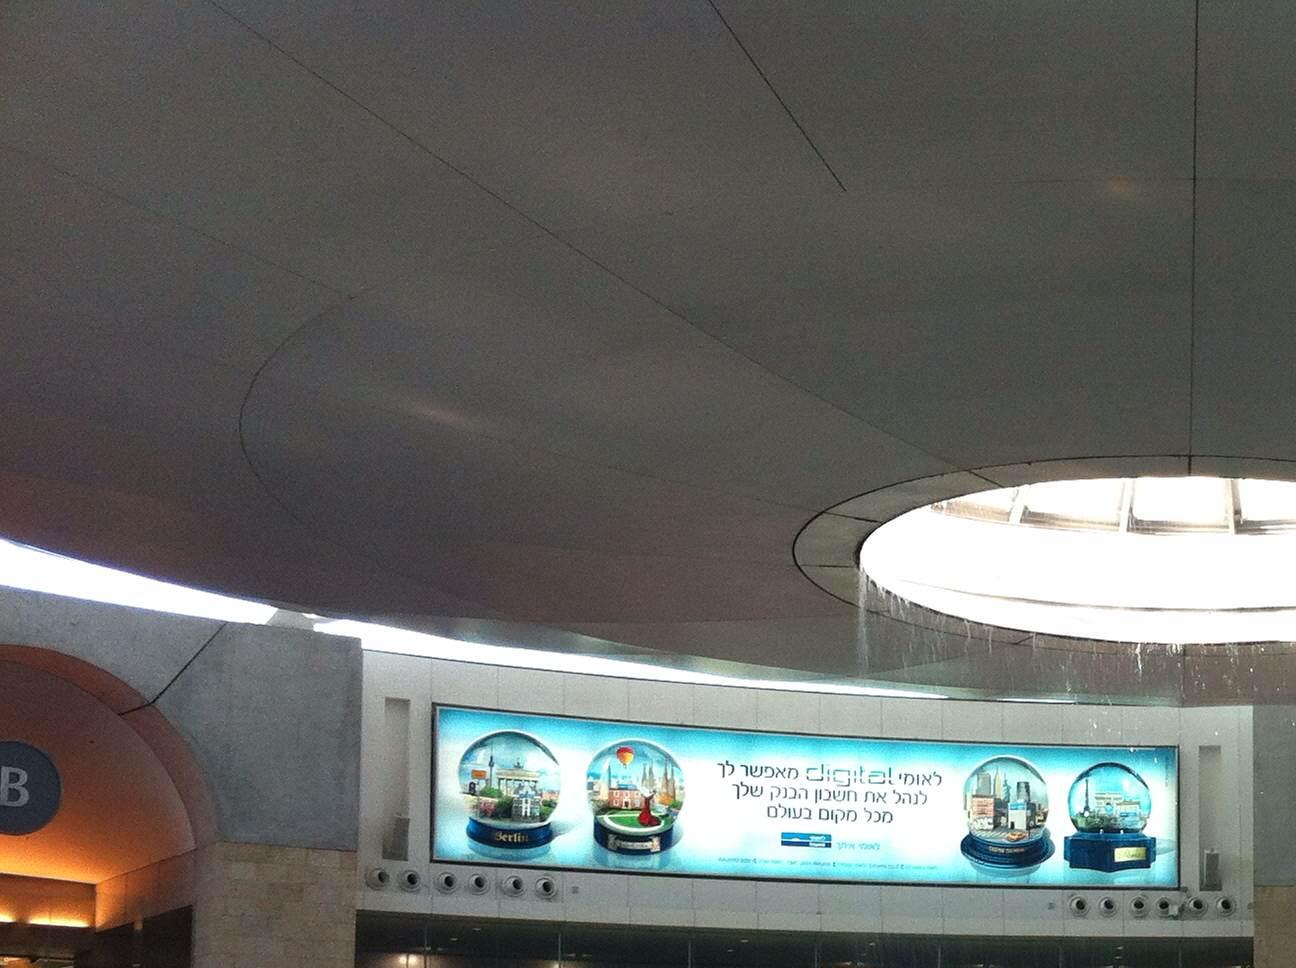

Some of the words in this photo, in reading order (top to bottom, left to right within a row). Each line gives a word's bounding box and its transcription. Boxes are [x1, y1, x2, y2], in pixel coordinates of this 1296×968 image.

[717, 760, 735, 778] לך
[740, 764, 799, 780] מאפשר
[806, 763, 894, 787] digital
[0, 766, 29, 807] B
[898, 771, 942, 786] לאומי
[732, 781, 763, 800] שלך
[770, 786, 808, 802] הבנק
[815, 789, 858, 804] חשבון
[864, 789, 887, 803] את
[892, 790, 928, 805] לנהל
[767, 804, 812, 820] בעולם
[818, 807, 858, 824] מקום
[864, 807, 893, 823] מכל
